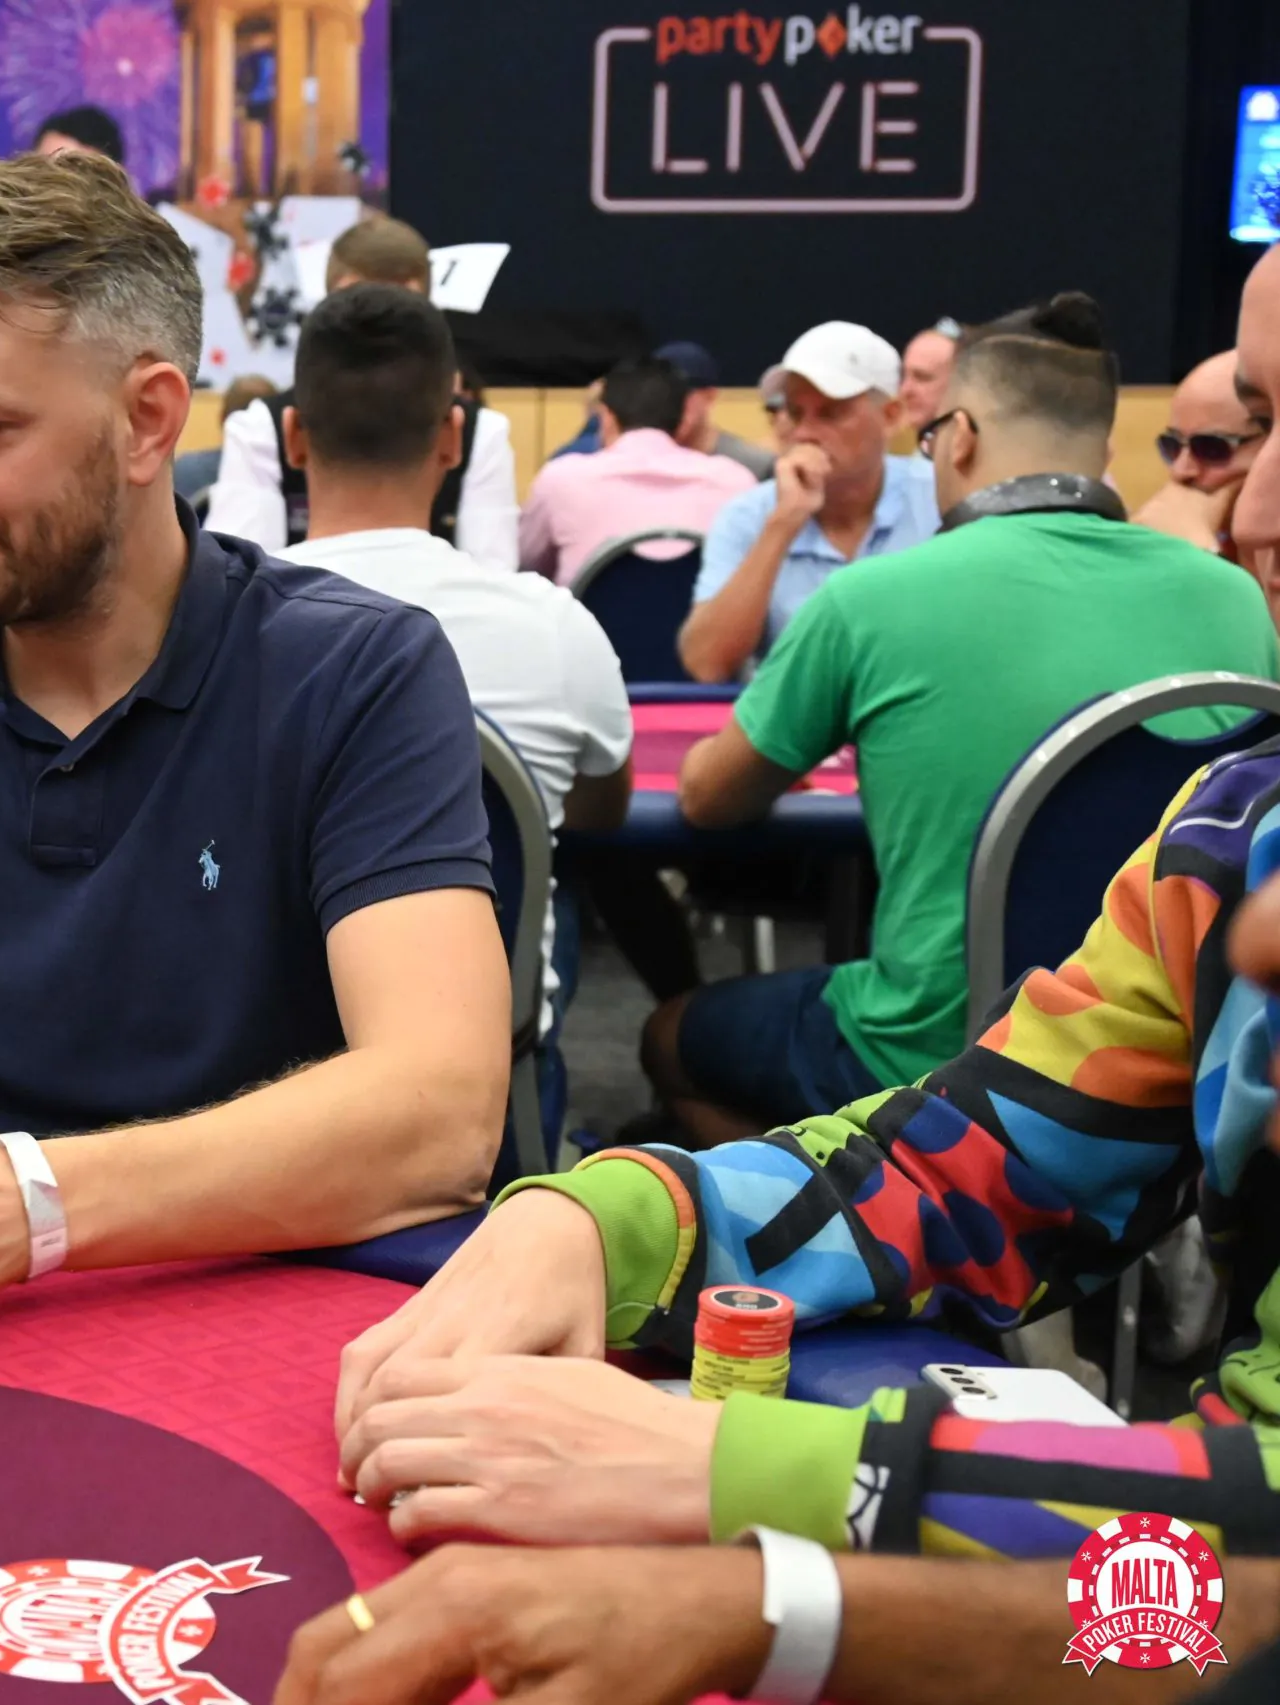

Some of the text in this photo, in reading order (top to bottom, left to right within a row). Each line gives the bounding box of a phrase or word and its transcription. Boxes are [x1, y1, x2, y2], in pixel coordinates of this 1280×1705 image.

[652, 80, 919, 173] LIVE
[118, 1571, 214, 1690] POKER FESTIVAL
